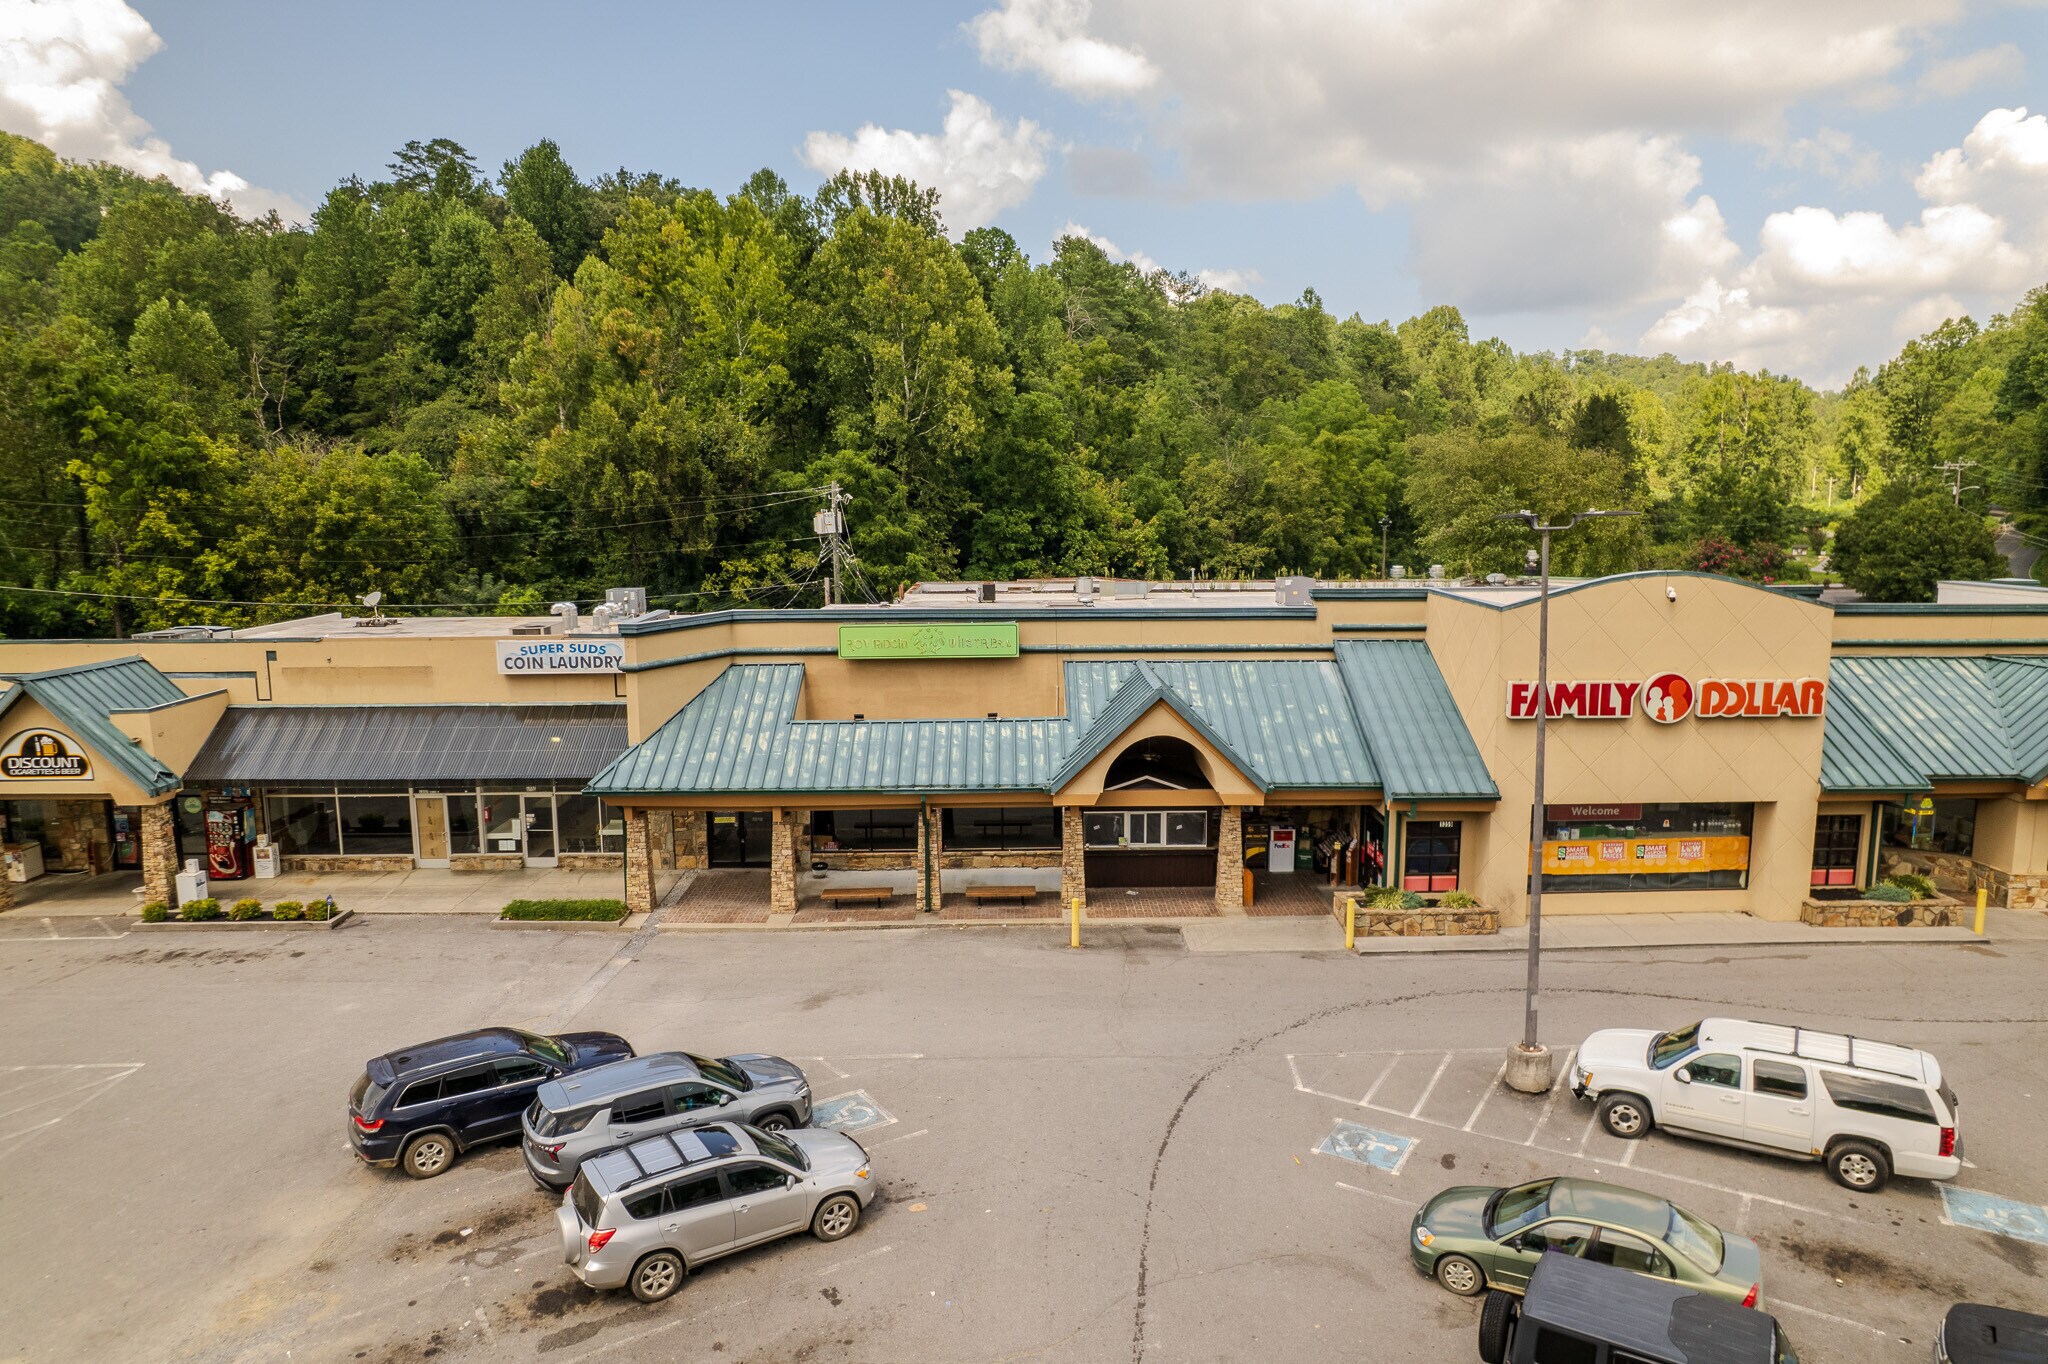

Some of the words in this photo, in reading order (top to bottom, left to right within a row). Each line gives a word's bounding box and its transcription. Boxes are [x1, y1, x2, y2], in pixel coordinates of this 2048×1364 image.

[520, 643, 564, 656] SUPER
[569, 643, 607, 655] SUDS
[504, 656, 544, 669] COIN
[549, 655, 623, 669] LAUNDRY
[1510, 683, 1640, 717] FAMILY
[1700, 681, 1824, 716] DOLLAR
[7, 757, 81, 769] DISCOUNT
[9, 768, 54, 776] CIGARETTES
[1571, 805, 1620, 816] Welcome
[1603, 846, 1623, 854] LOW
[1681, 845, 1701, 853] LOW
